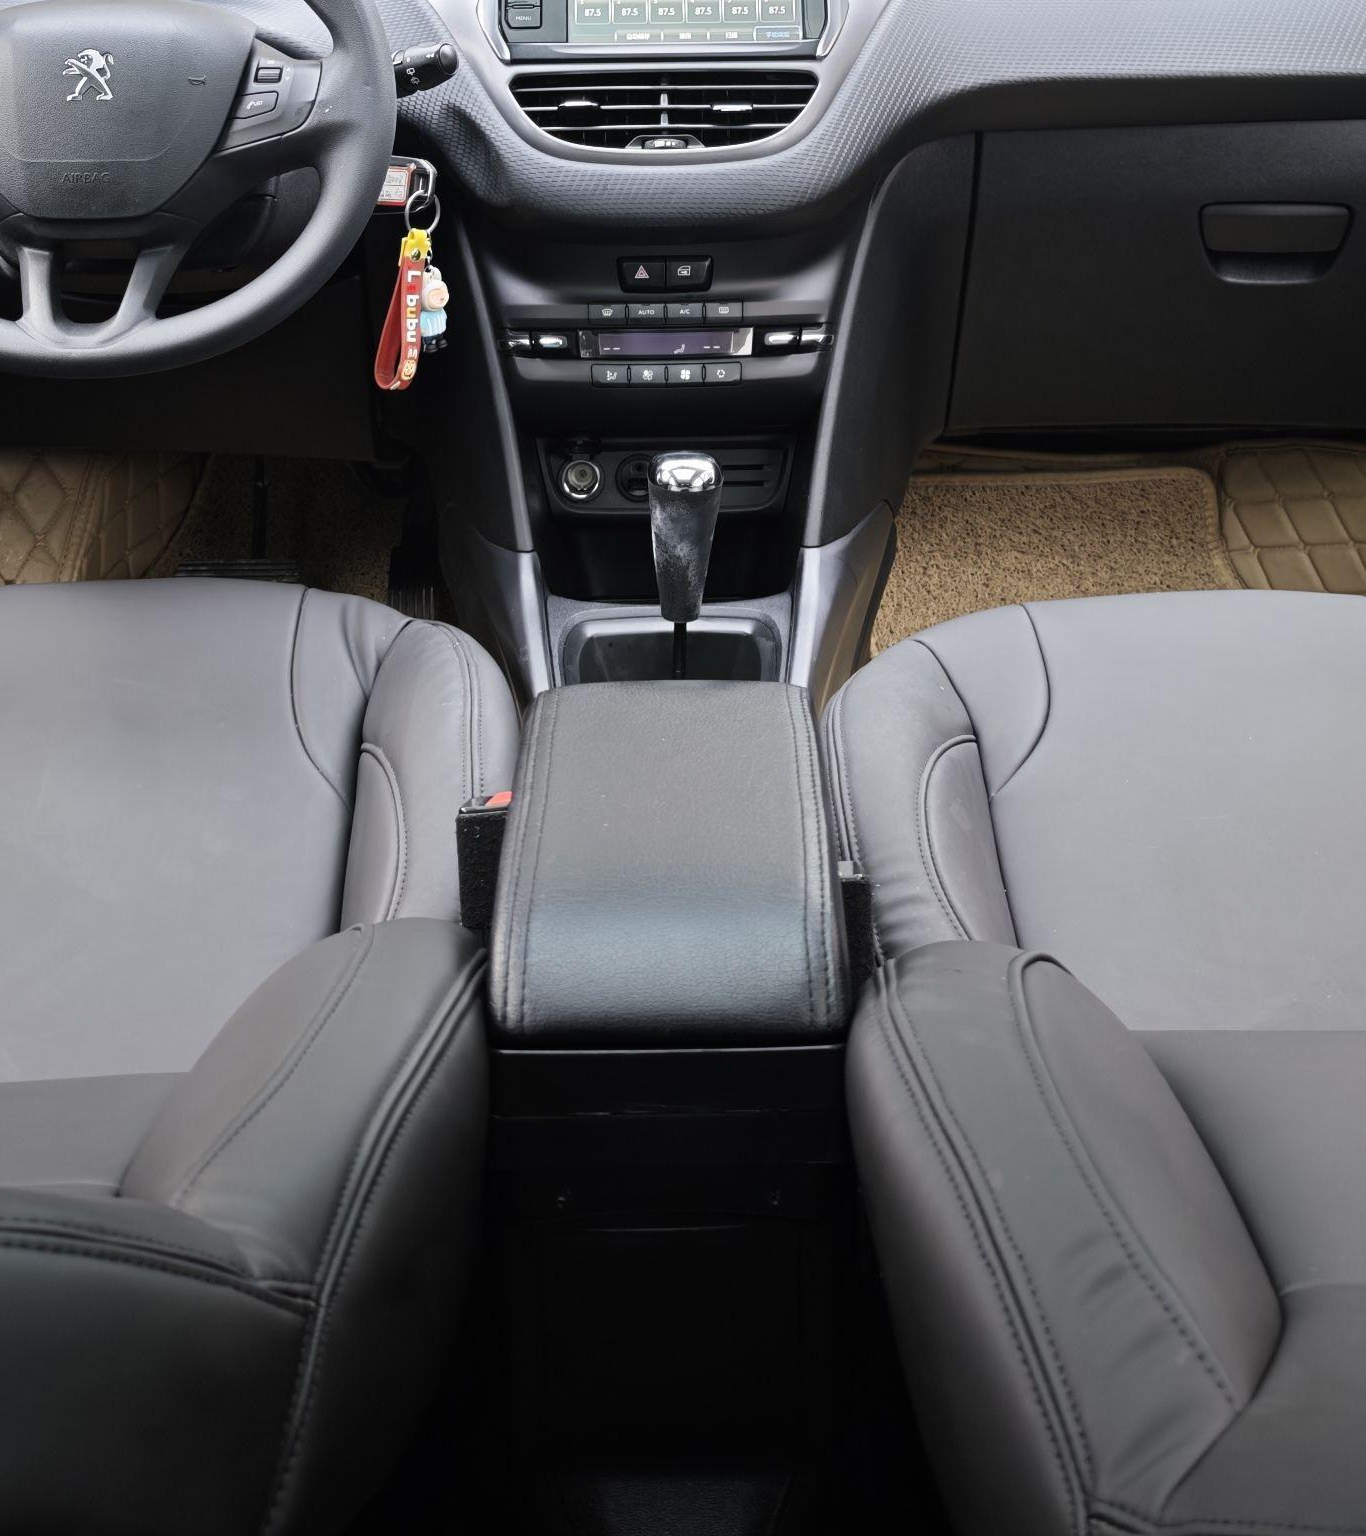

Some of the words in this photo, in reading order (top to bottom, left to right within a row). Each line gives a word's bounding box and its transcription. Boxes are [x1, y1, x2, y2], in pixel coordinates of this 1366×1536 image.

[584, 8, 602, 17] 87.5
[621, 7, 639, 16] 87.5
[658, 7, 676, 16] 87.5
[695, 6, 712, 15] 87.5
[731, 6, 749, 15] 87.5
[768, 6, 786, 15] 87.5
[61, 172, 110, 184] AIRBAG
